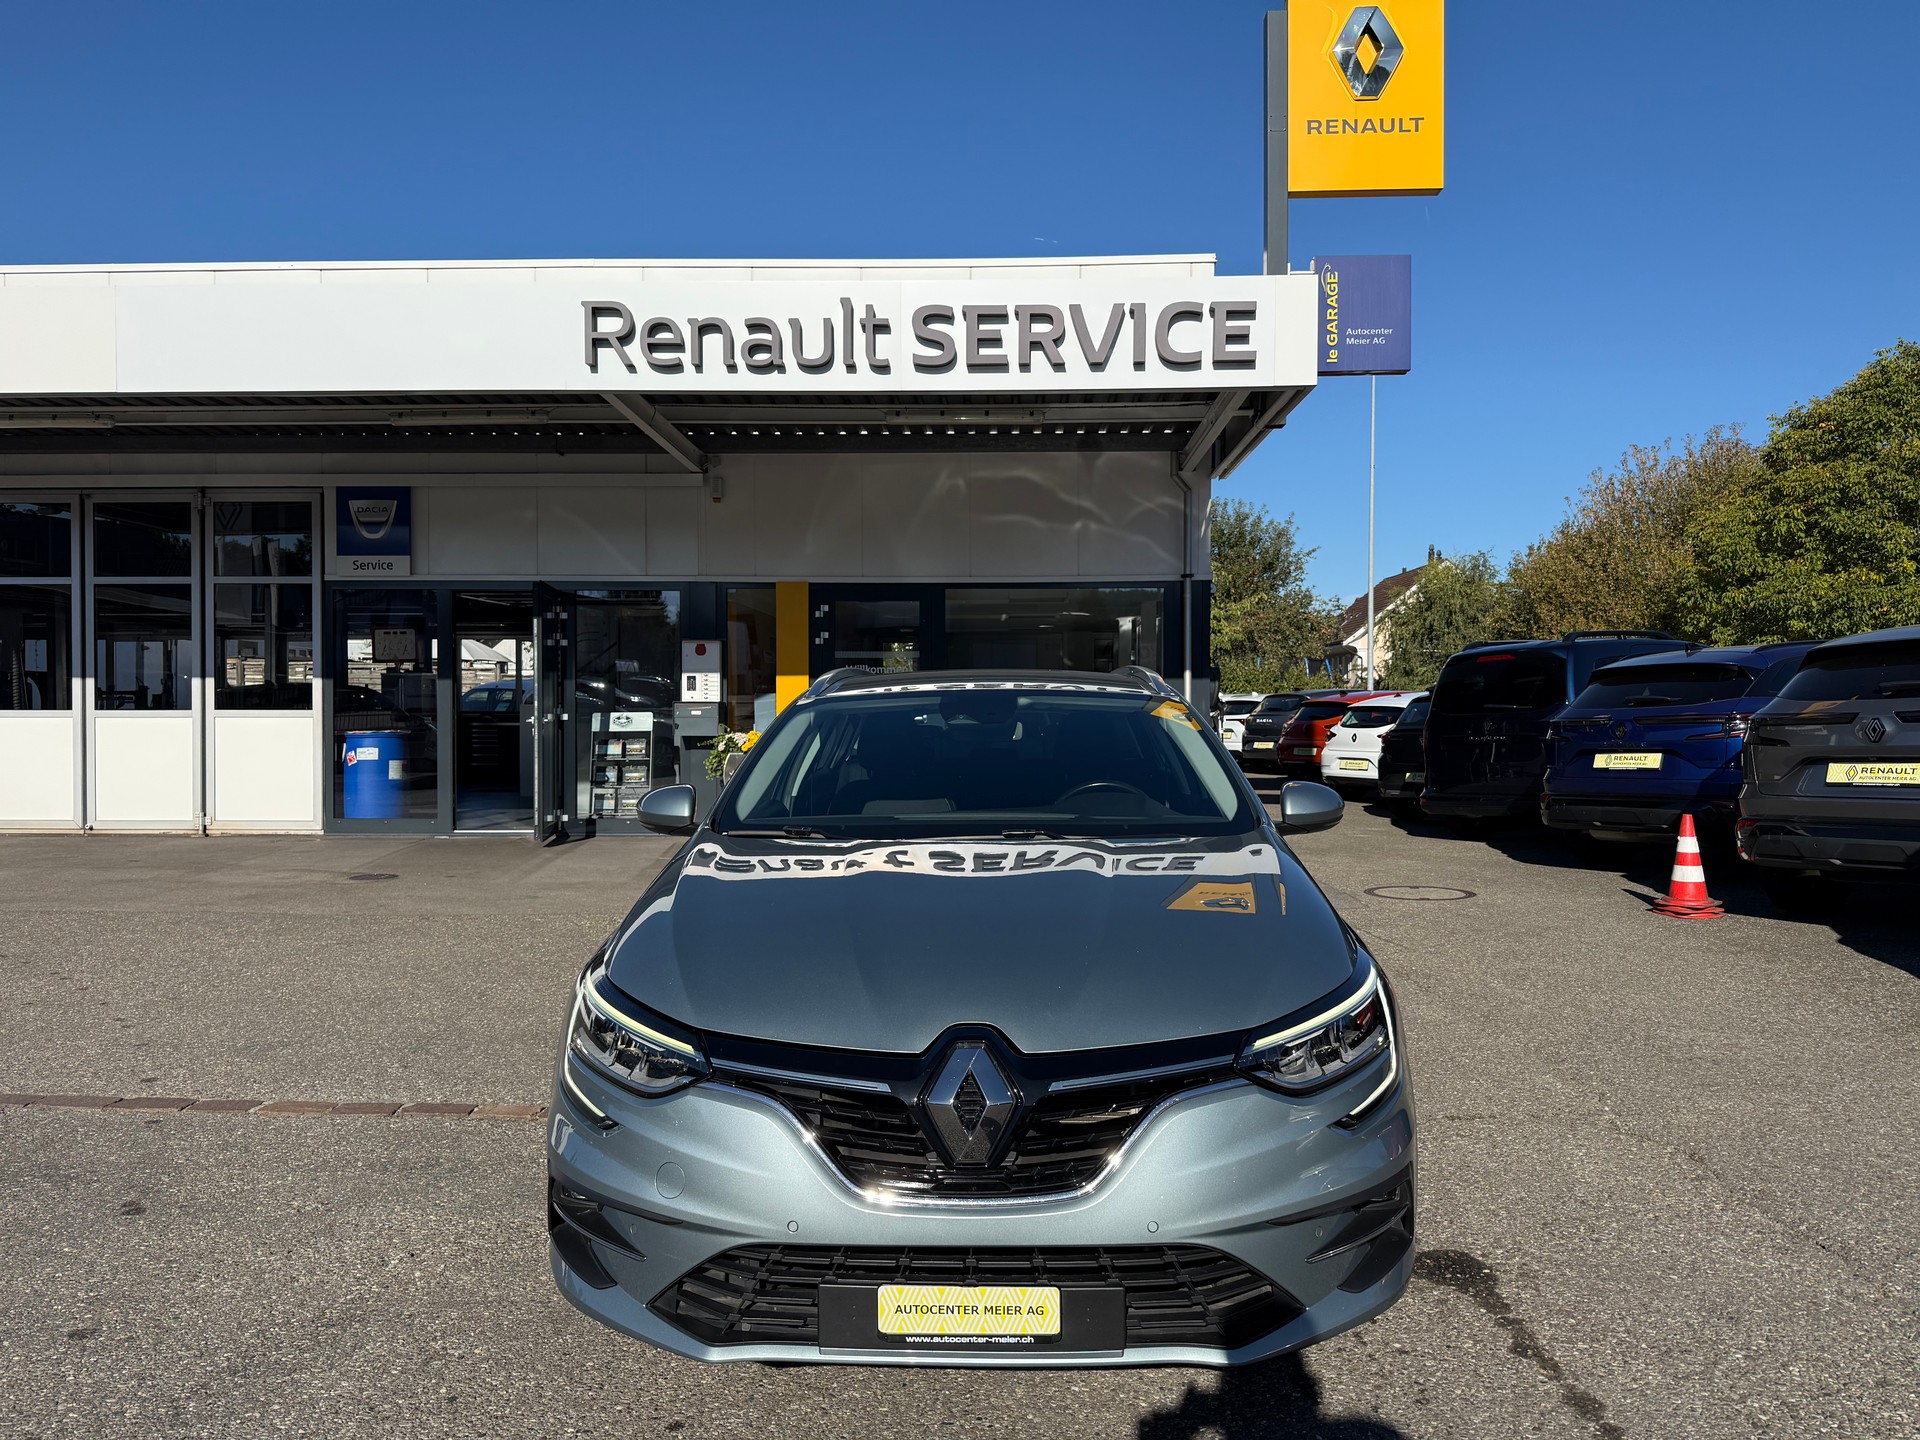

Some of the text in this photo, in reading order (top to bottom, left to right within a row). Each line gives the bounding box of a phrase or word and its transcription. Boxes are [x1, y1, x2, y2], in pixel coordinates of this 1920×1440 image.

[1306, 117, 1425, 135] RENAULT
[1326, 271, 1338, 363] le GARAGE
[581, 297, 1257, 375] Renault SERVICE
[352, 560, 394, 571] Service
[1860, 767, 1917, 775] RENAULT
[895, 1304, 1045, 1316] AUTOCENTER MEIER AG
[905, 1335, 1034, 1344] www.autocenter-meier.ch
